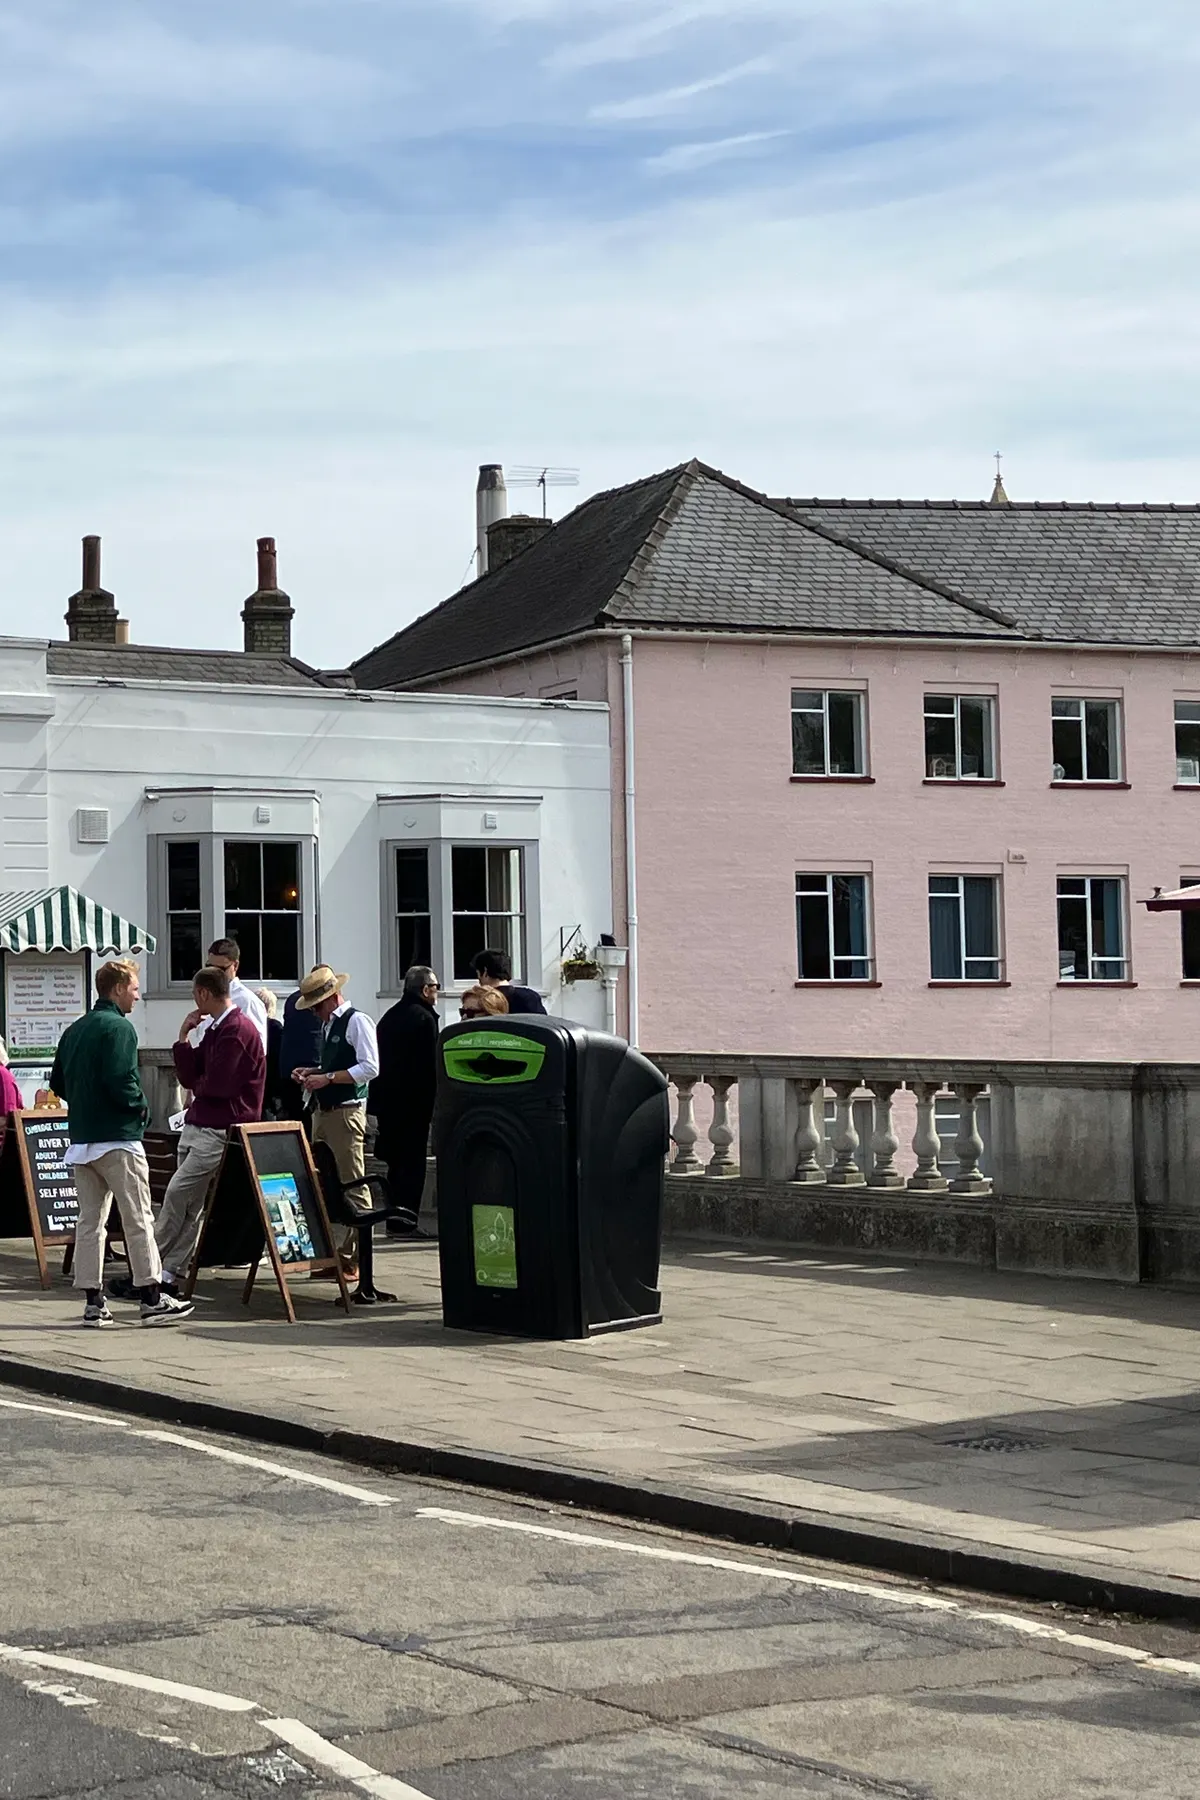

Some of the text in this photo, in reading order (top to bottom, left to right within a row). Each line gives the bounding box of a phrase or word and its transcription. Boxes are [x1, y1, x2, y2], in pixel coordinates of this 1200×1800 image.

[38, 1138, 63, 1148] RIVER
[35, 1152, 57, 1160] ADULTS
[36, 1162, 67, 1170] STUDENTS
[39, 1187, 78, 1198] SELF HIRE
